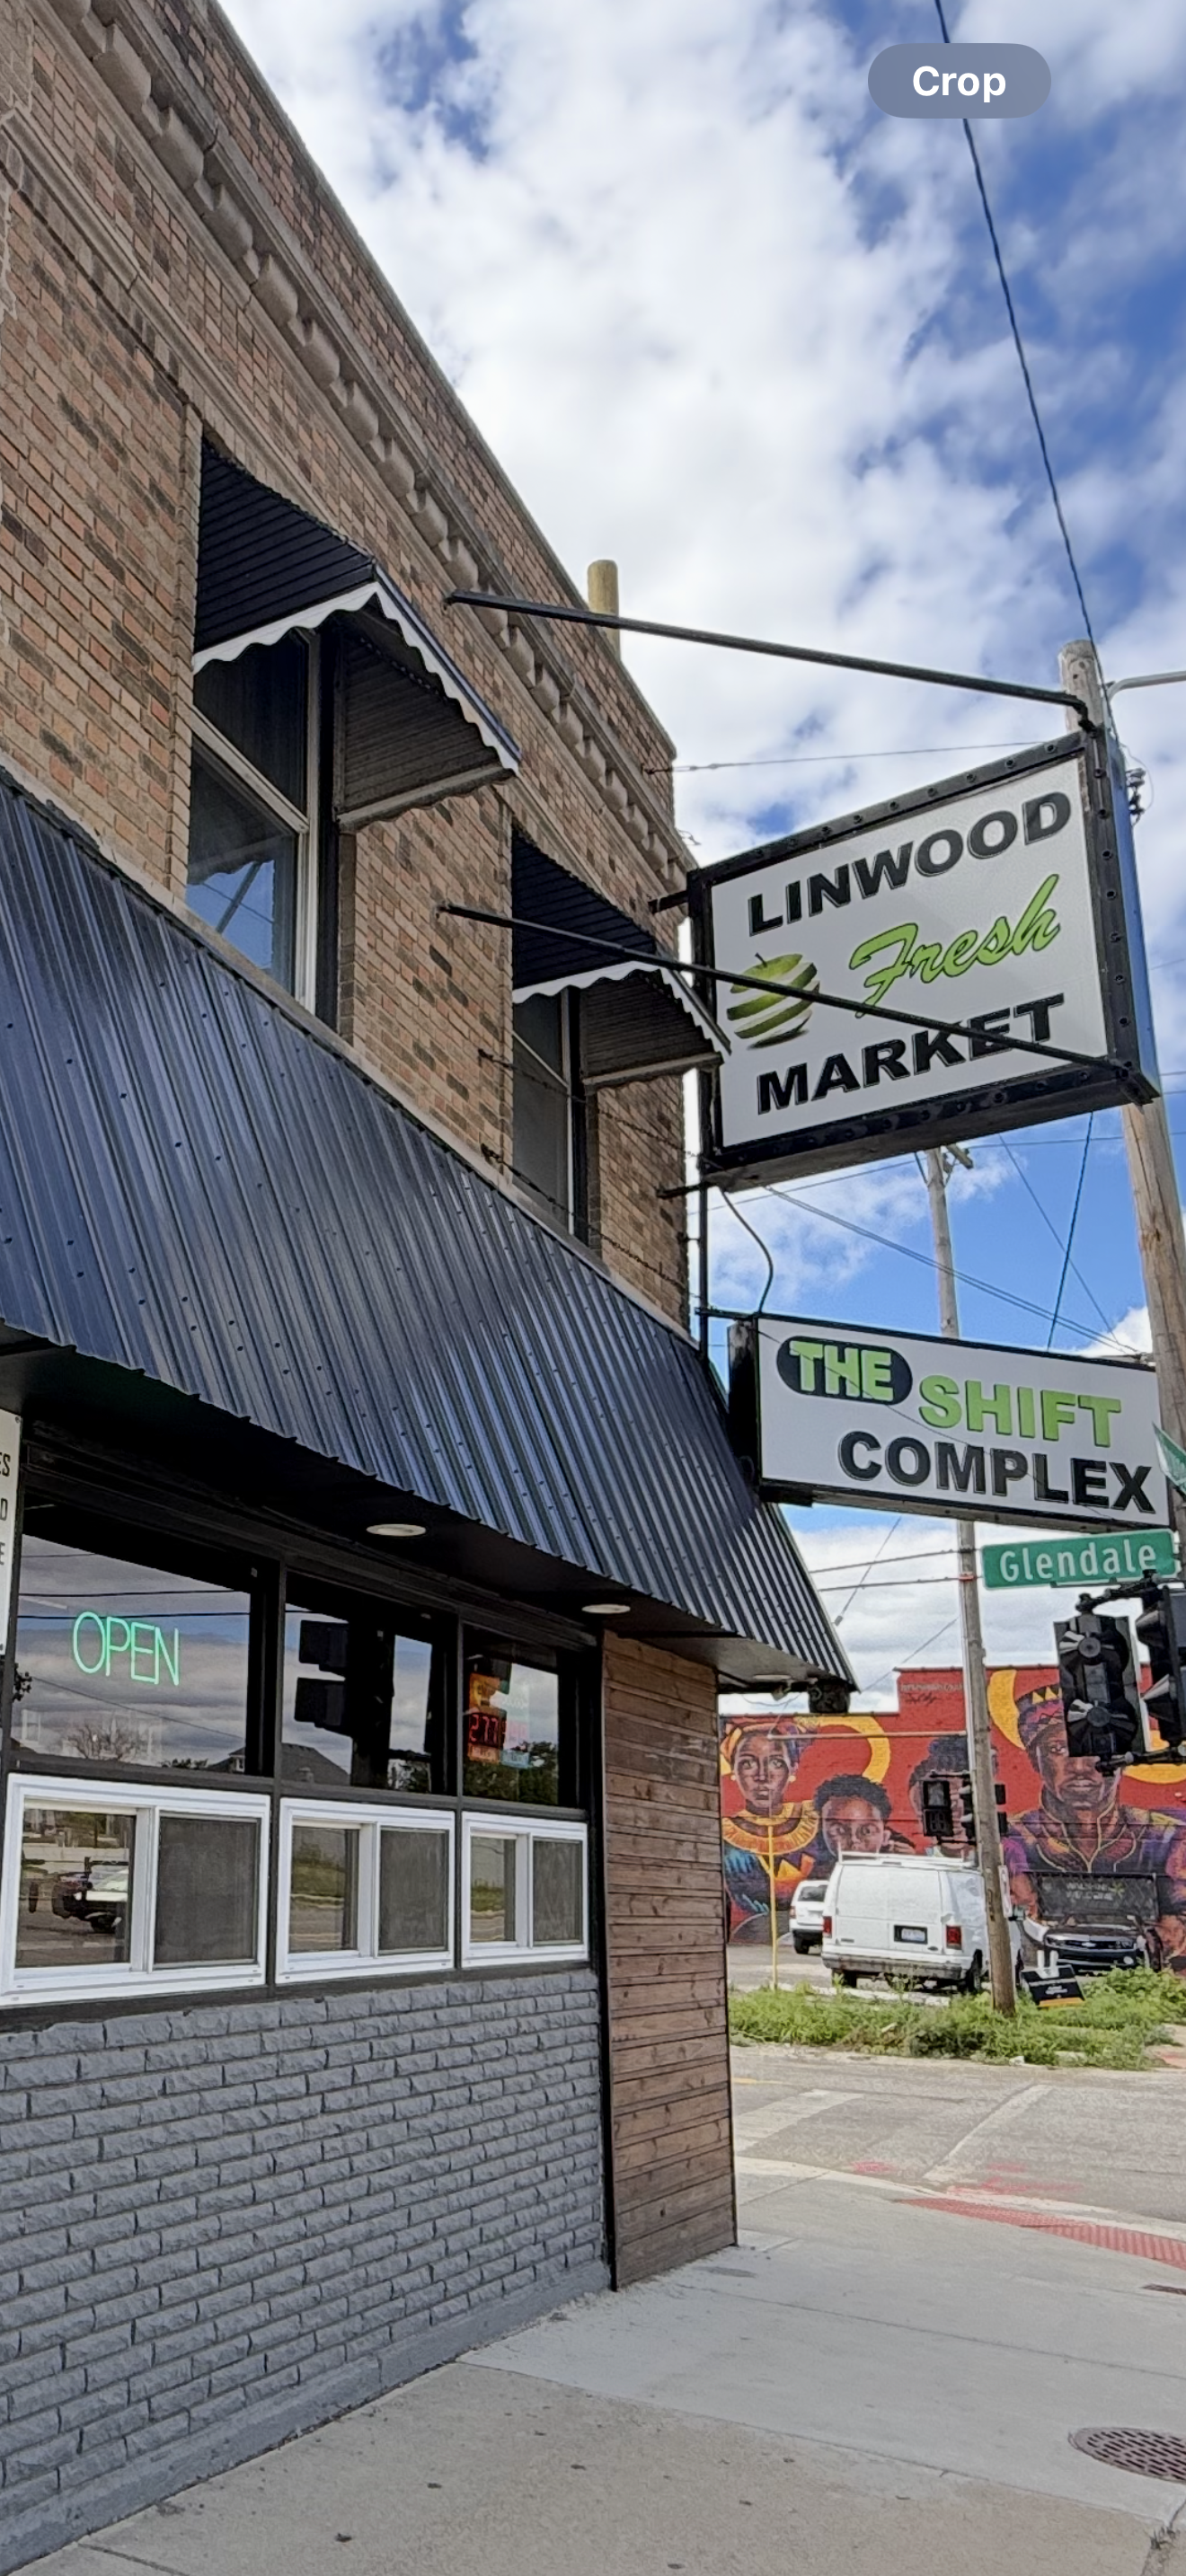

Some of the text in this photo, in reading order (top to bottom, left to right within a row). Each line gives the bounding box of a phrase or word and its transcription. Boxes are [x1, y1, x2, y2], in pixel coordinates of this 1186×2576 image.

[748, 791, 1072, 937] LINWOOD
[848, 873, 1061, 1019] Fresh
[757, 992, 1065, 1116] MARKET
[789, 1340, 1121, 1448] THE SHIFT
[837, 1431, 1156, 1514] COMPLEX
[999, 1539, 1156, 1583] Glendale
[73, 1611, 180, 1686] OPEN
